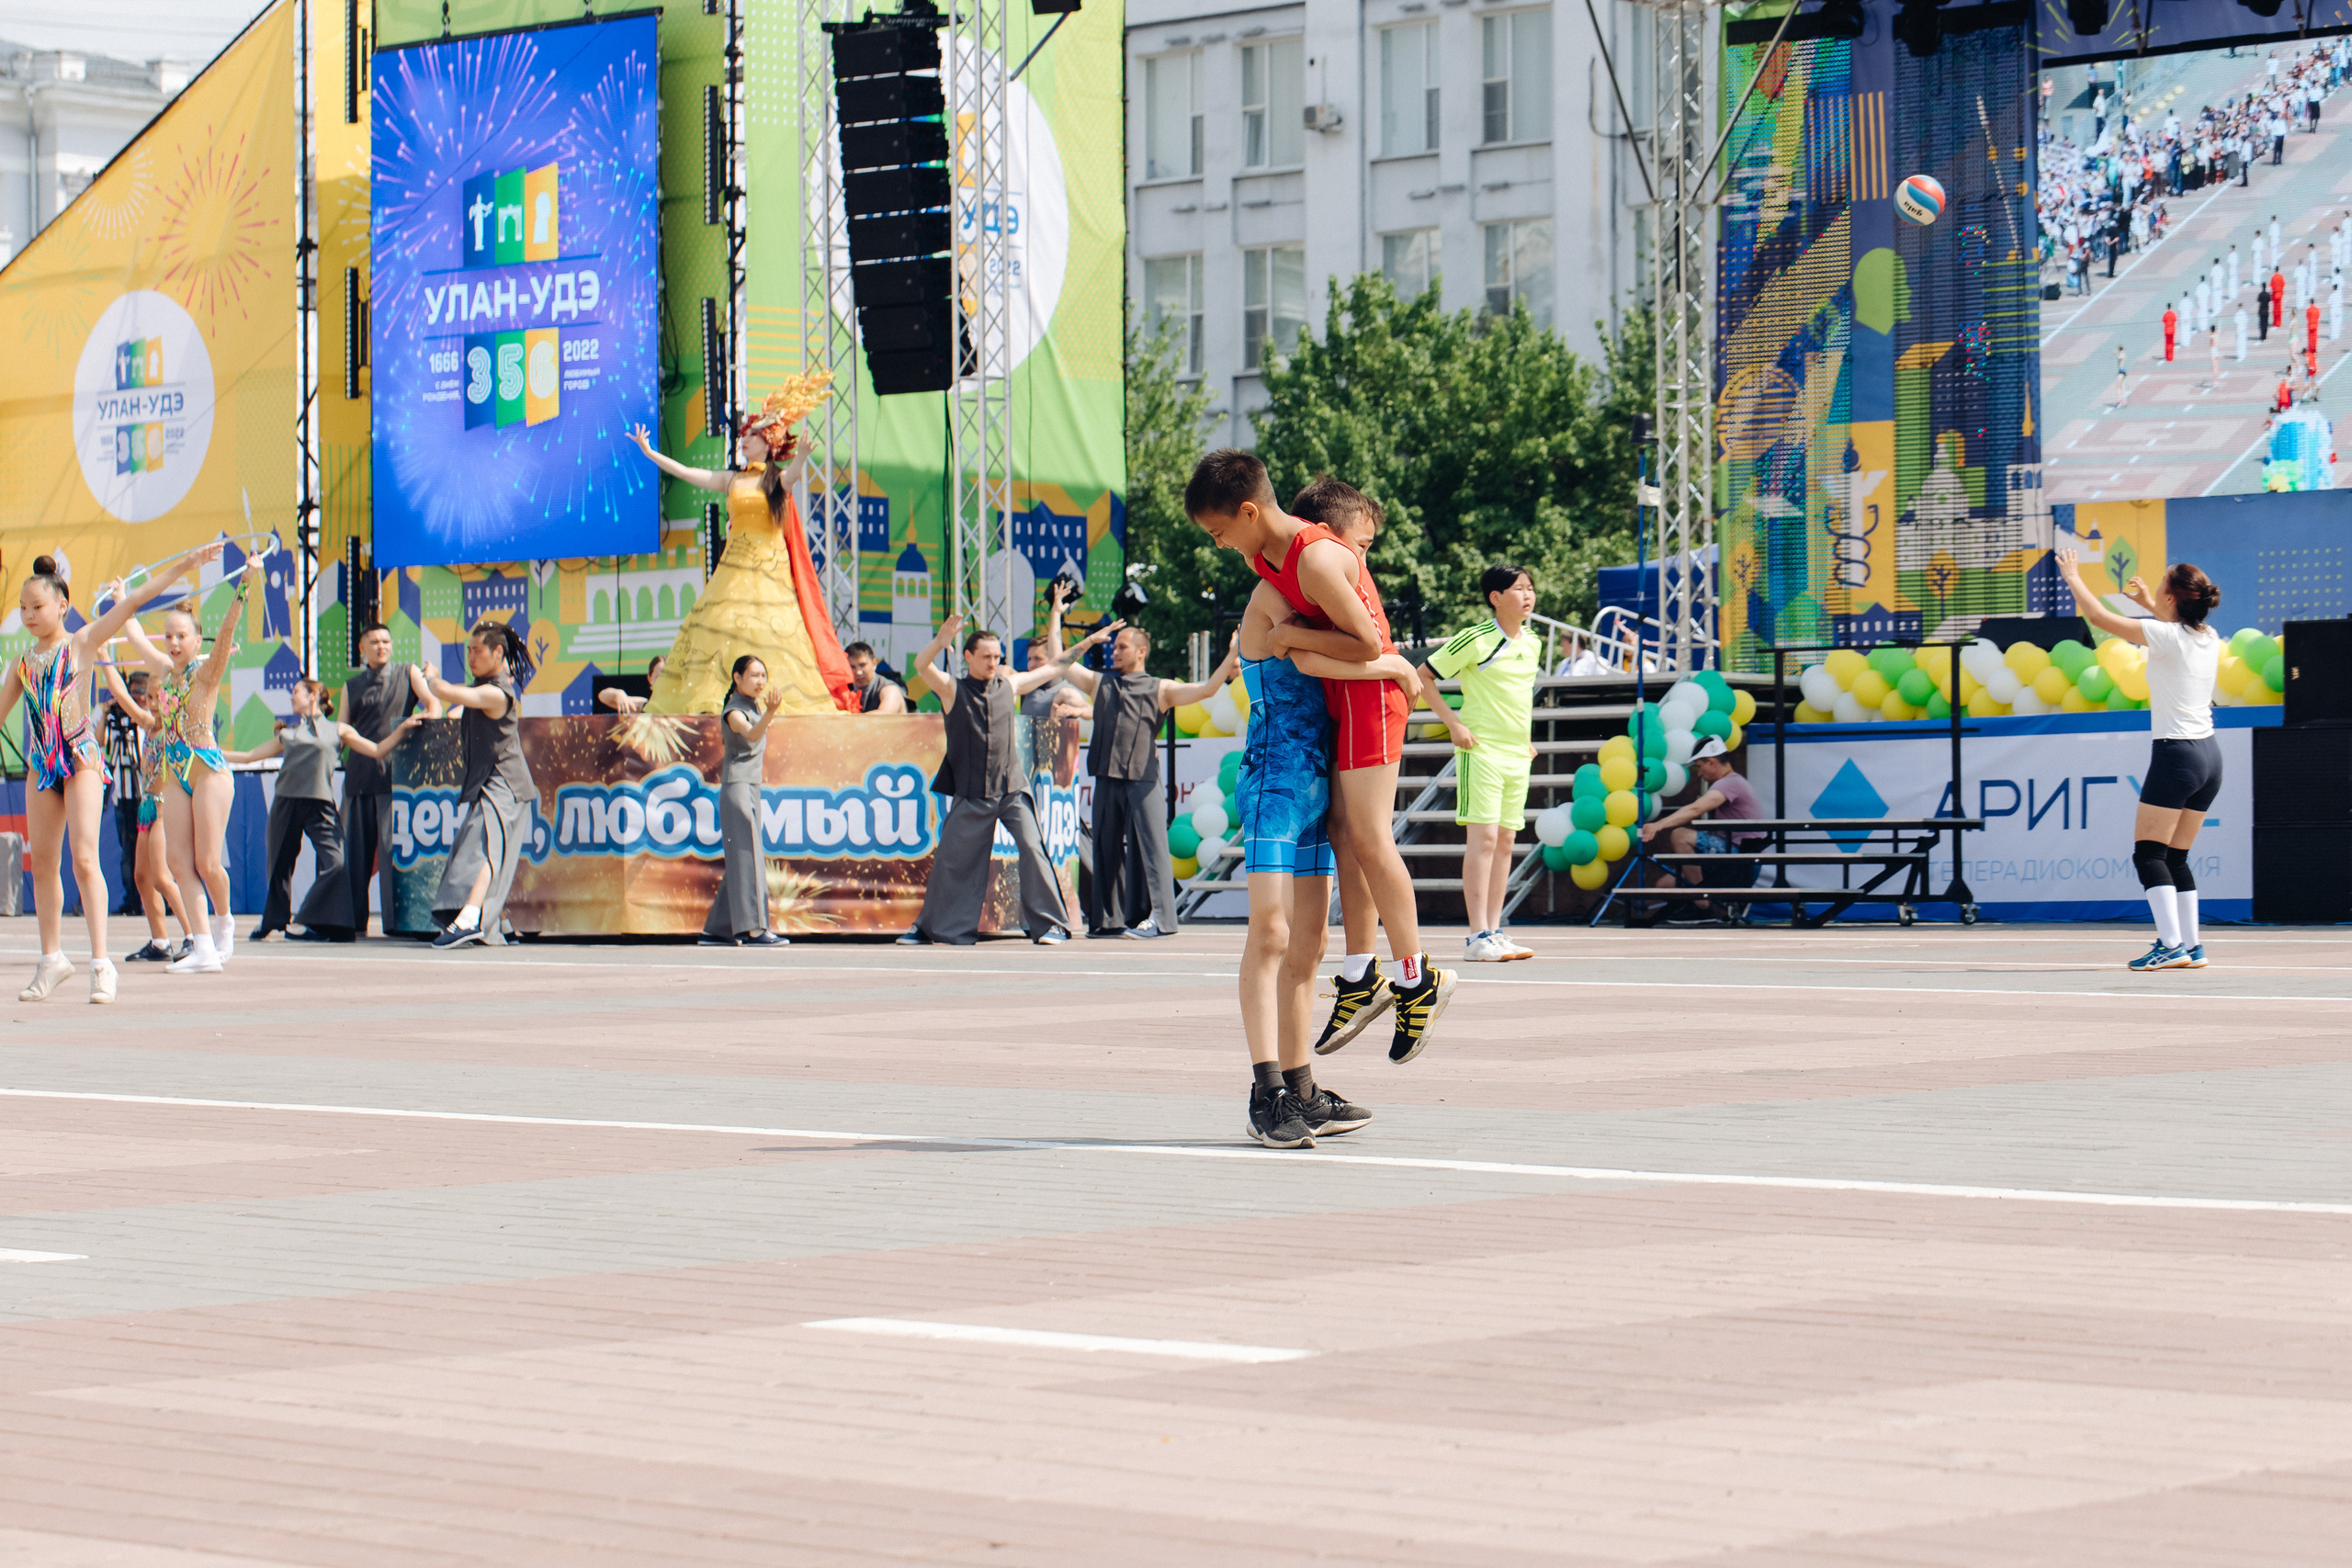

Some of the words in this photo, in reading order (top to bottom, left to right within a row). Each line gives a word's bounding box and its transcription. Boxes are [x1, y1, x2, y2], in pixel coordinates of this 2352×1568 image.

[424, 269, 601, 326] УЛАН-УДЭ
[429, 351, 459, 374] 1666
[467, 341, 558, 404] 356
[562, 338, 600, 363] 2022
[97, 391, 185, 421] УЛАН-УДЭ
